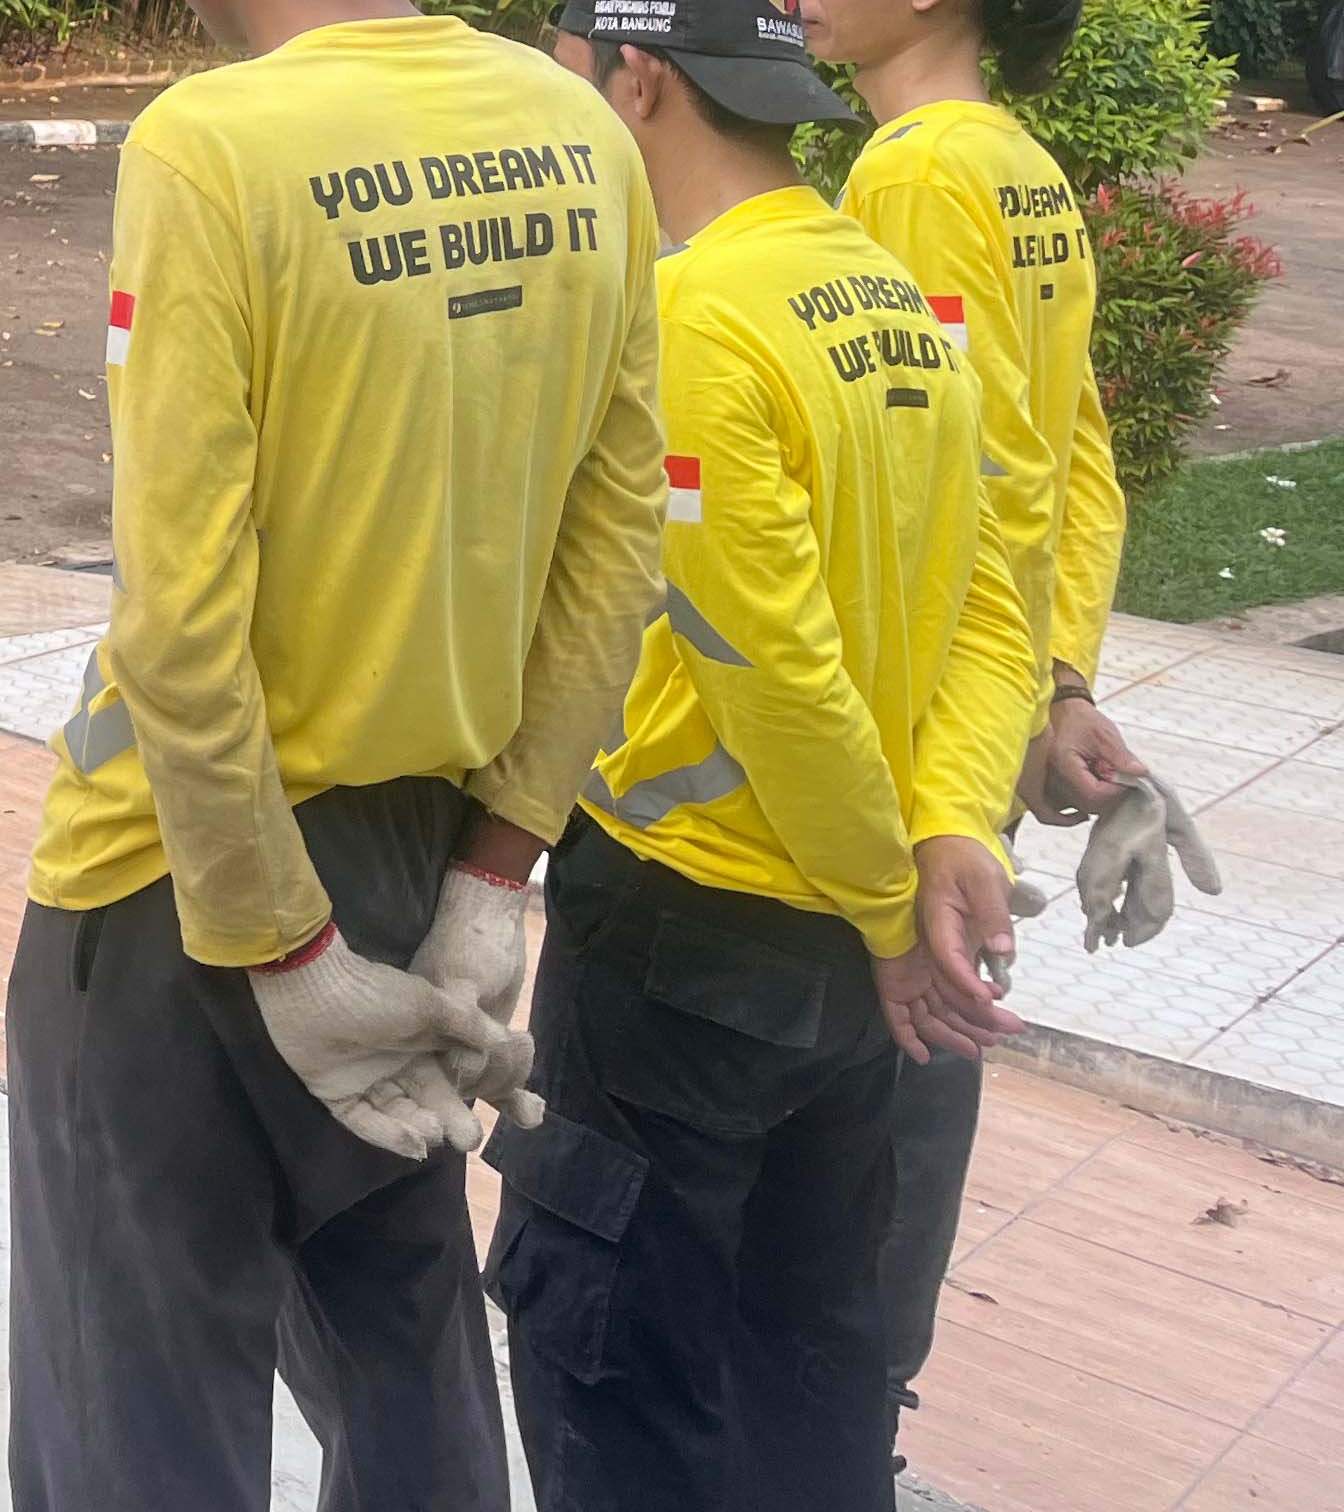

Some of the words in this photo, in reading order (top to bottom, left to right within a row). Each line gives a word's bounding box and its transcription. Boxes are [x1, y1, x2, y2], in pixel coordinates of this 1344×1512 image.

[594, 16, 618, 30] KOTA
[621, 17, 672, 33] BANDUNG
[309, 160, 414, 220] YOU
[419, 145, 566, 200] DREAM
[562, 144, 597, 184] IT
[347, 228, 432, 286] WE
[439, 212, 554, 270] BUILD
[566, 207, 598, 252] IT
[787, 279, 855, 331] YOU
[847, 275, 929, 316] DREAM
[826, 334, 877, 383] WE
